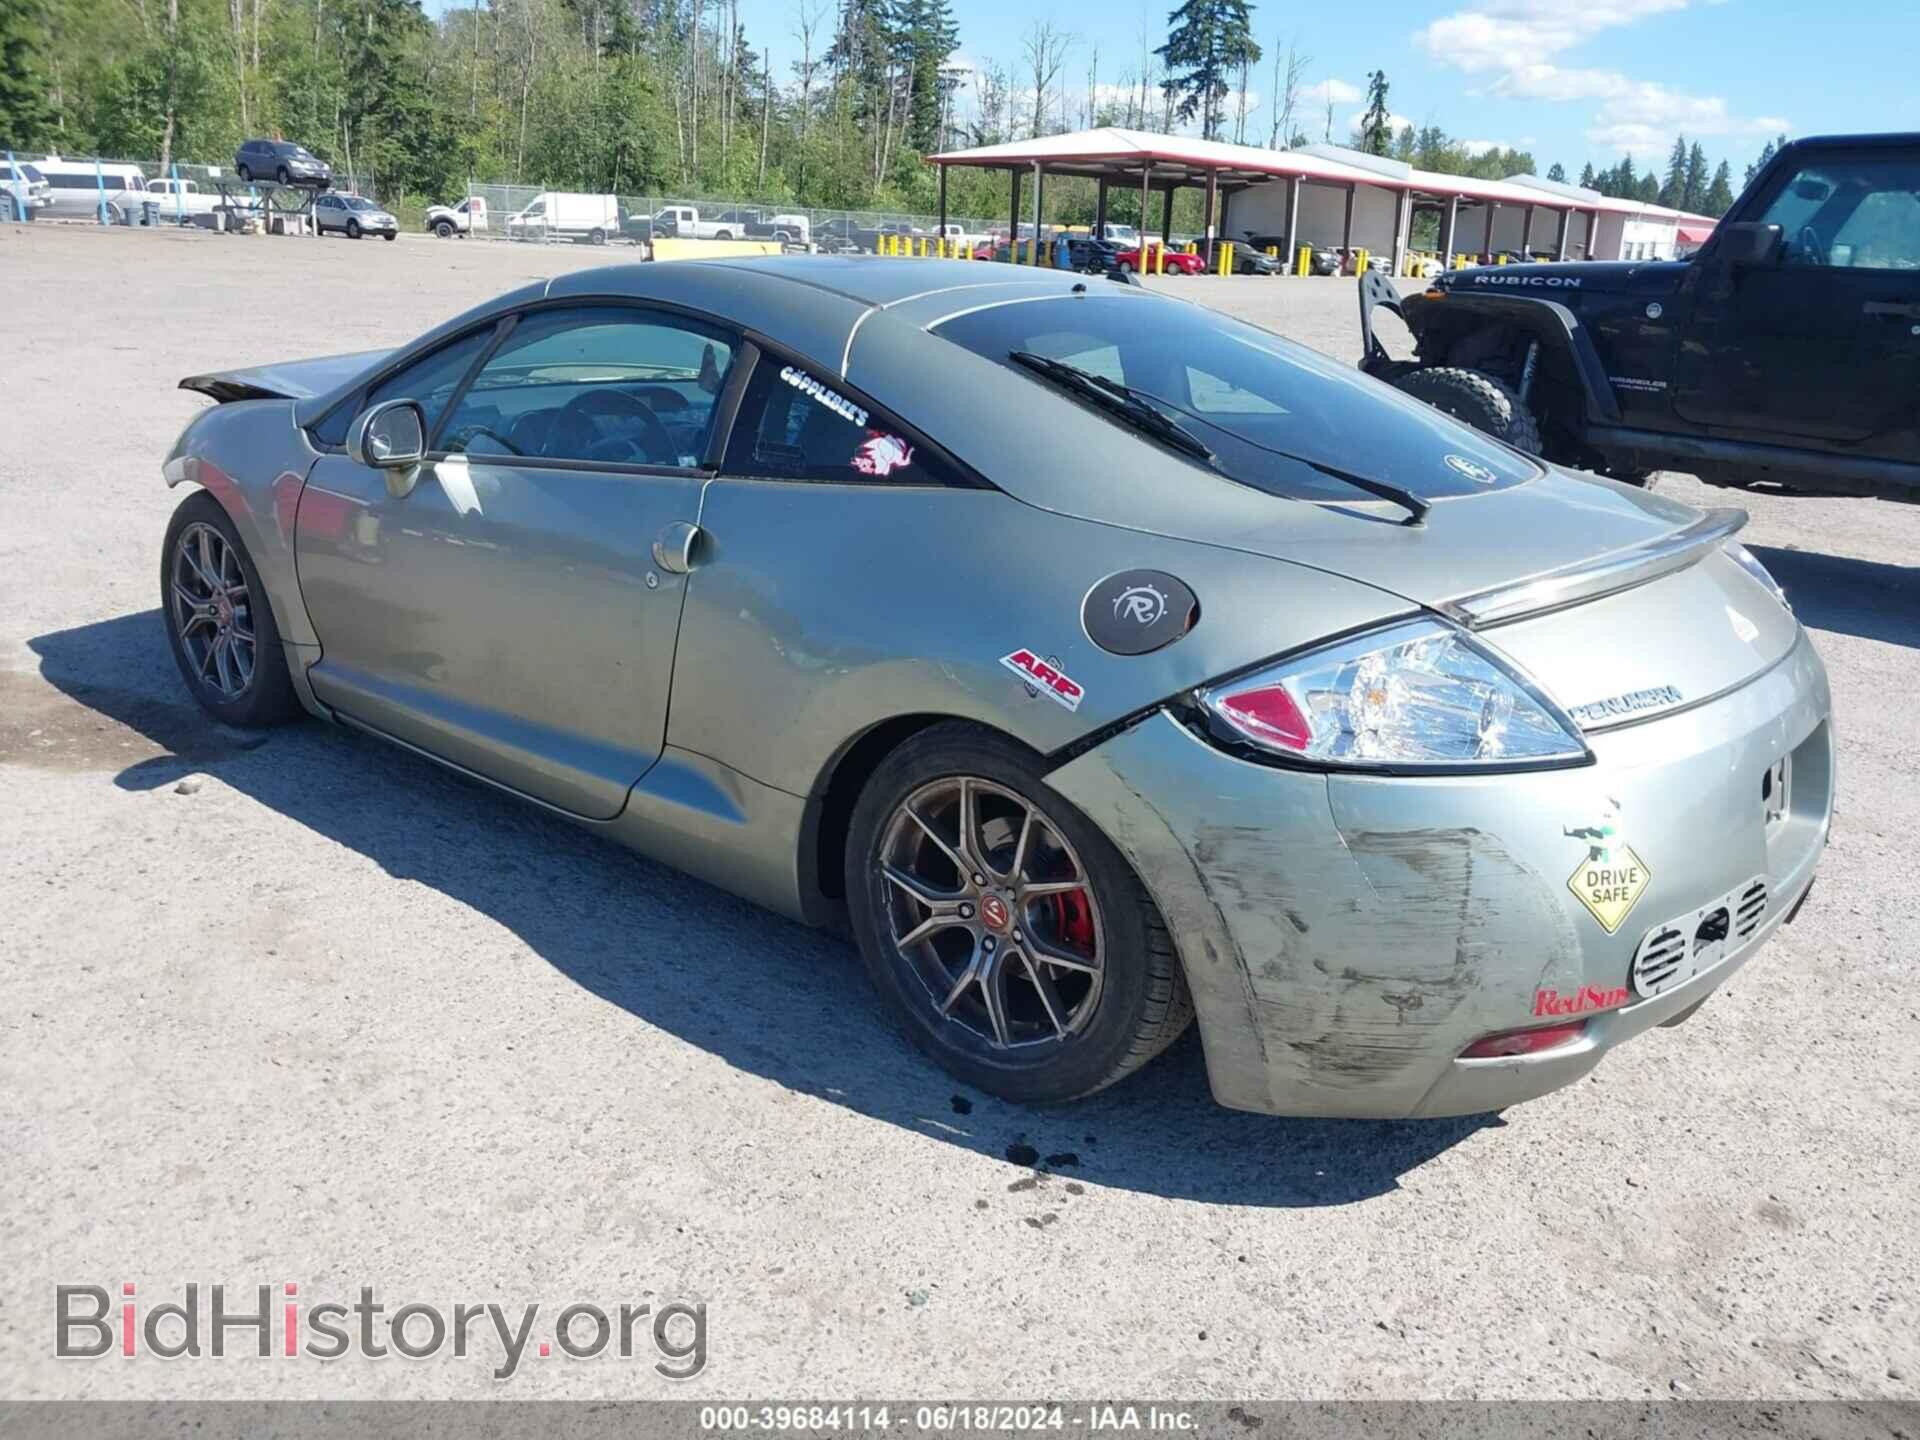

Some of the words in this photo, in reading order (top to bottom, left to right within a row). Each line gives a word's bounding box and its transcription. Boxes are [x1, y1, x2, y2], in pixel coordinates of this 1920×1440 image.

[1473, 275, 1582, 287] RUBICON
[1009, 650, 1081, 698] ARP
[1586, 867, 1637, 887] DRIVE
[1592, 886, 1629, 903] SAFE
